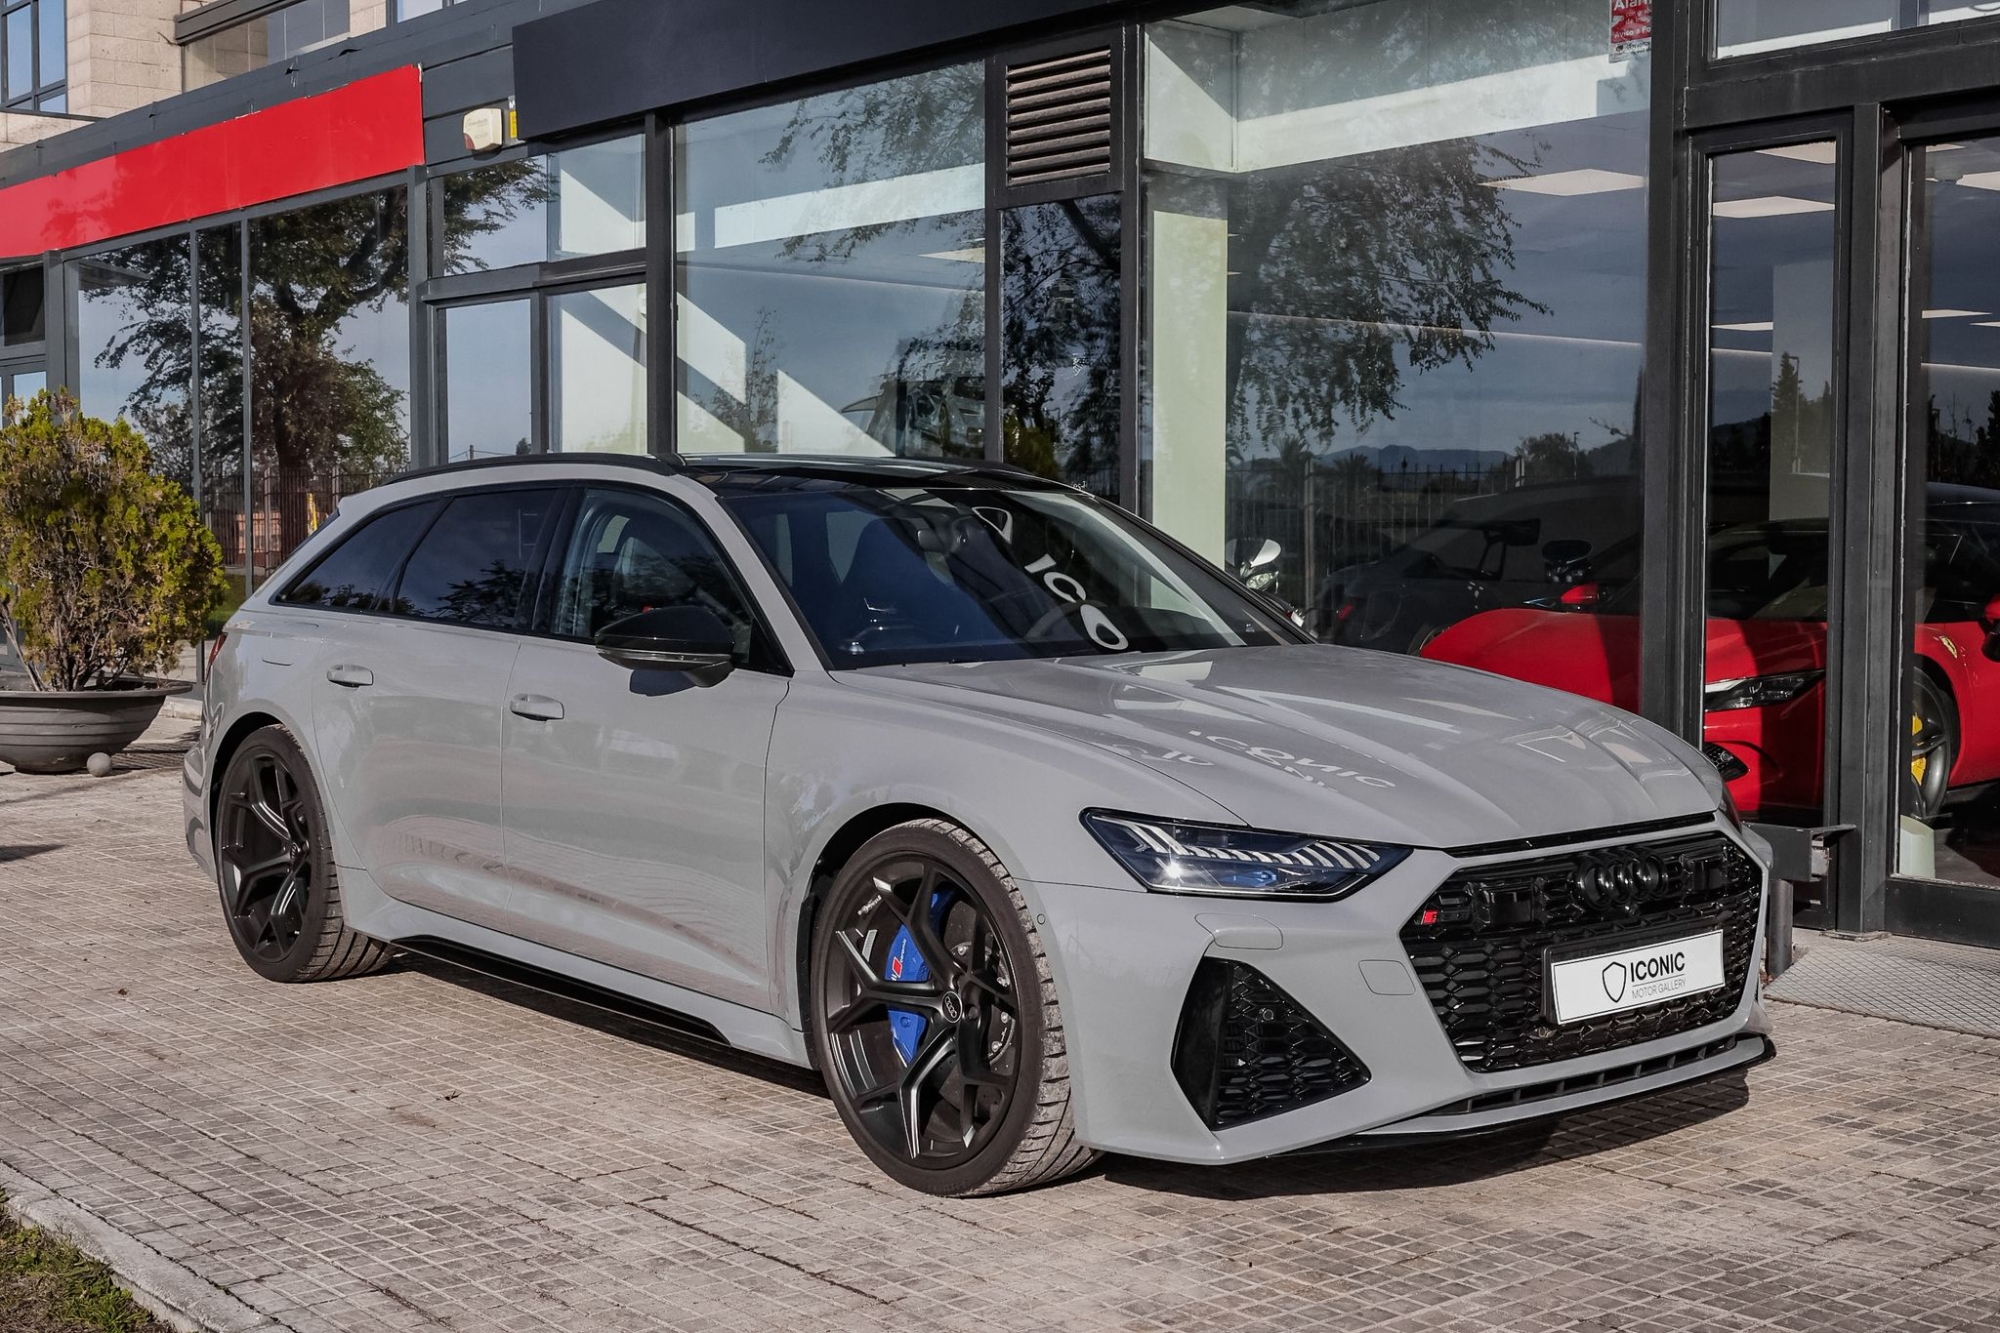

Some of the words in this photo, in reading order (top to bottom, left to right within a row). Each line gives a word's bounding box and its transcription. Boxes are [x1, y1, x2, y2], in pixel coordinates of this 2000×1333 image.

[1630, 951, 1685, 982] ICONIC
[1631, 984, 1658, 999] MOTOR
[1658, 978, 1687, 993] GALLERY
